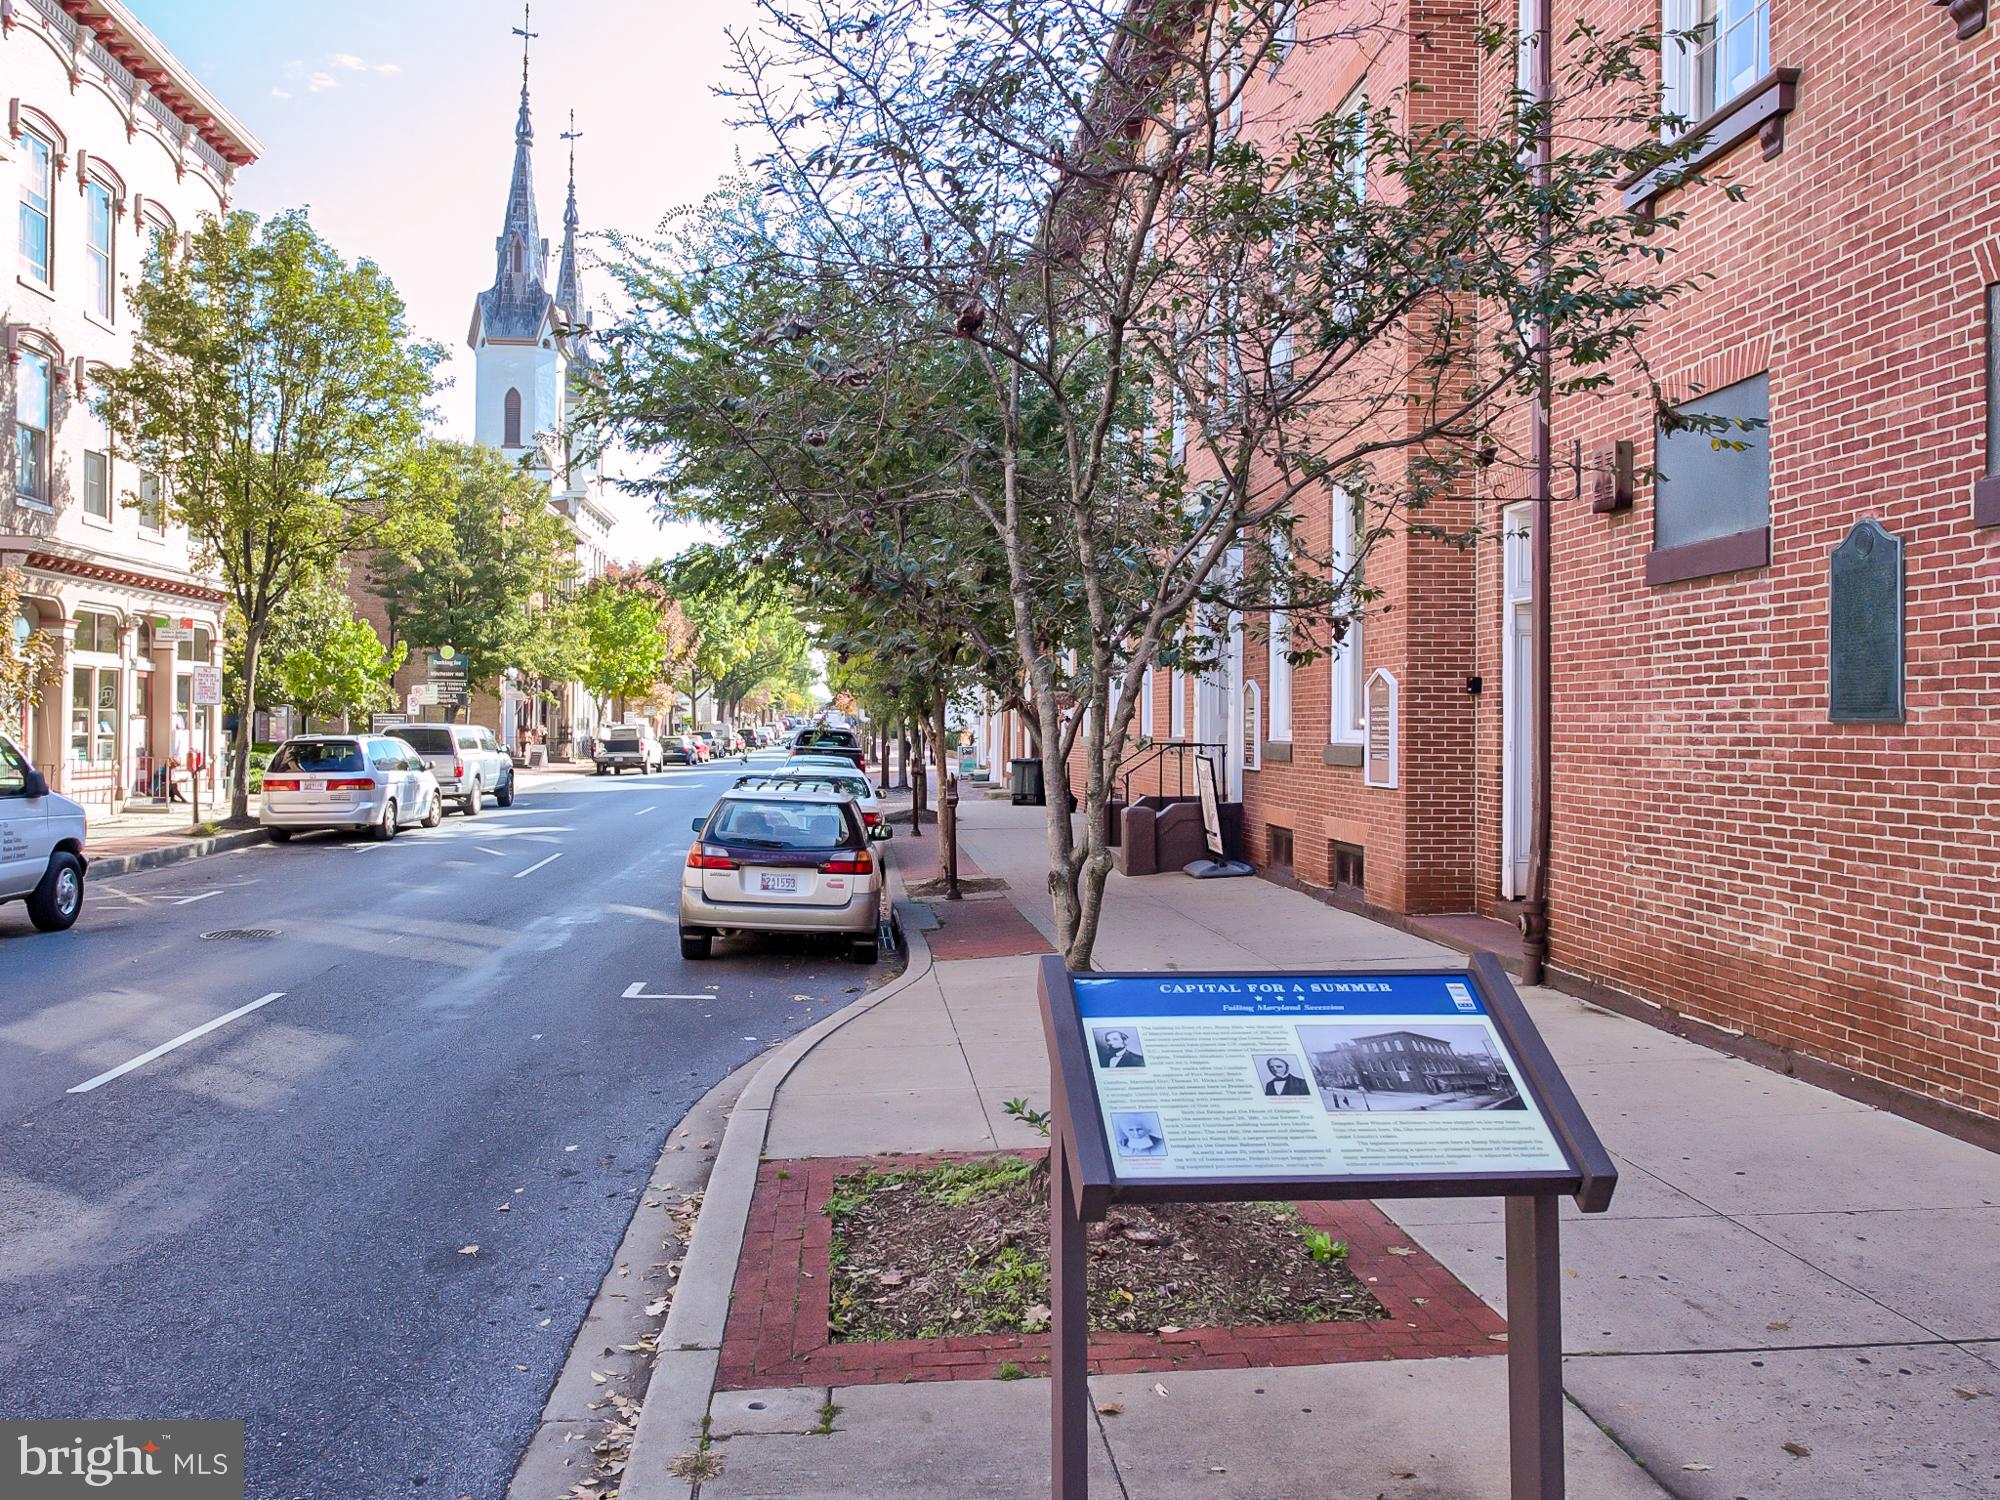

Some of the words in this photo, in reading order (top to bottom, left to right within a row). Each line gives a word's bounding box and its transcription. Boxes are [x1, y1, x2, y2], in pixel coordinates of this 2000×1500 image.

[1159, 984, 1242, 993] CAPITAL
[1246, 984, 1286, 993] FOR
[1292, 984, 1305, 993] A
[1310, 984, 1393, 993] SUMMER
[1257, 1004, 1302, 1012] Maryland
[1303, 1003, 1345, 1012] Secession
